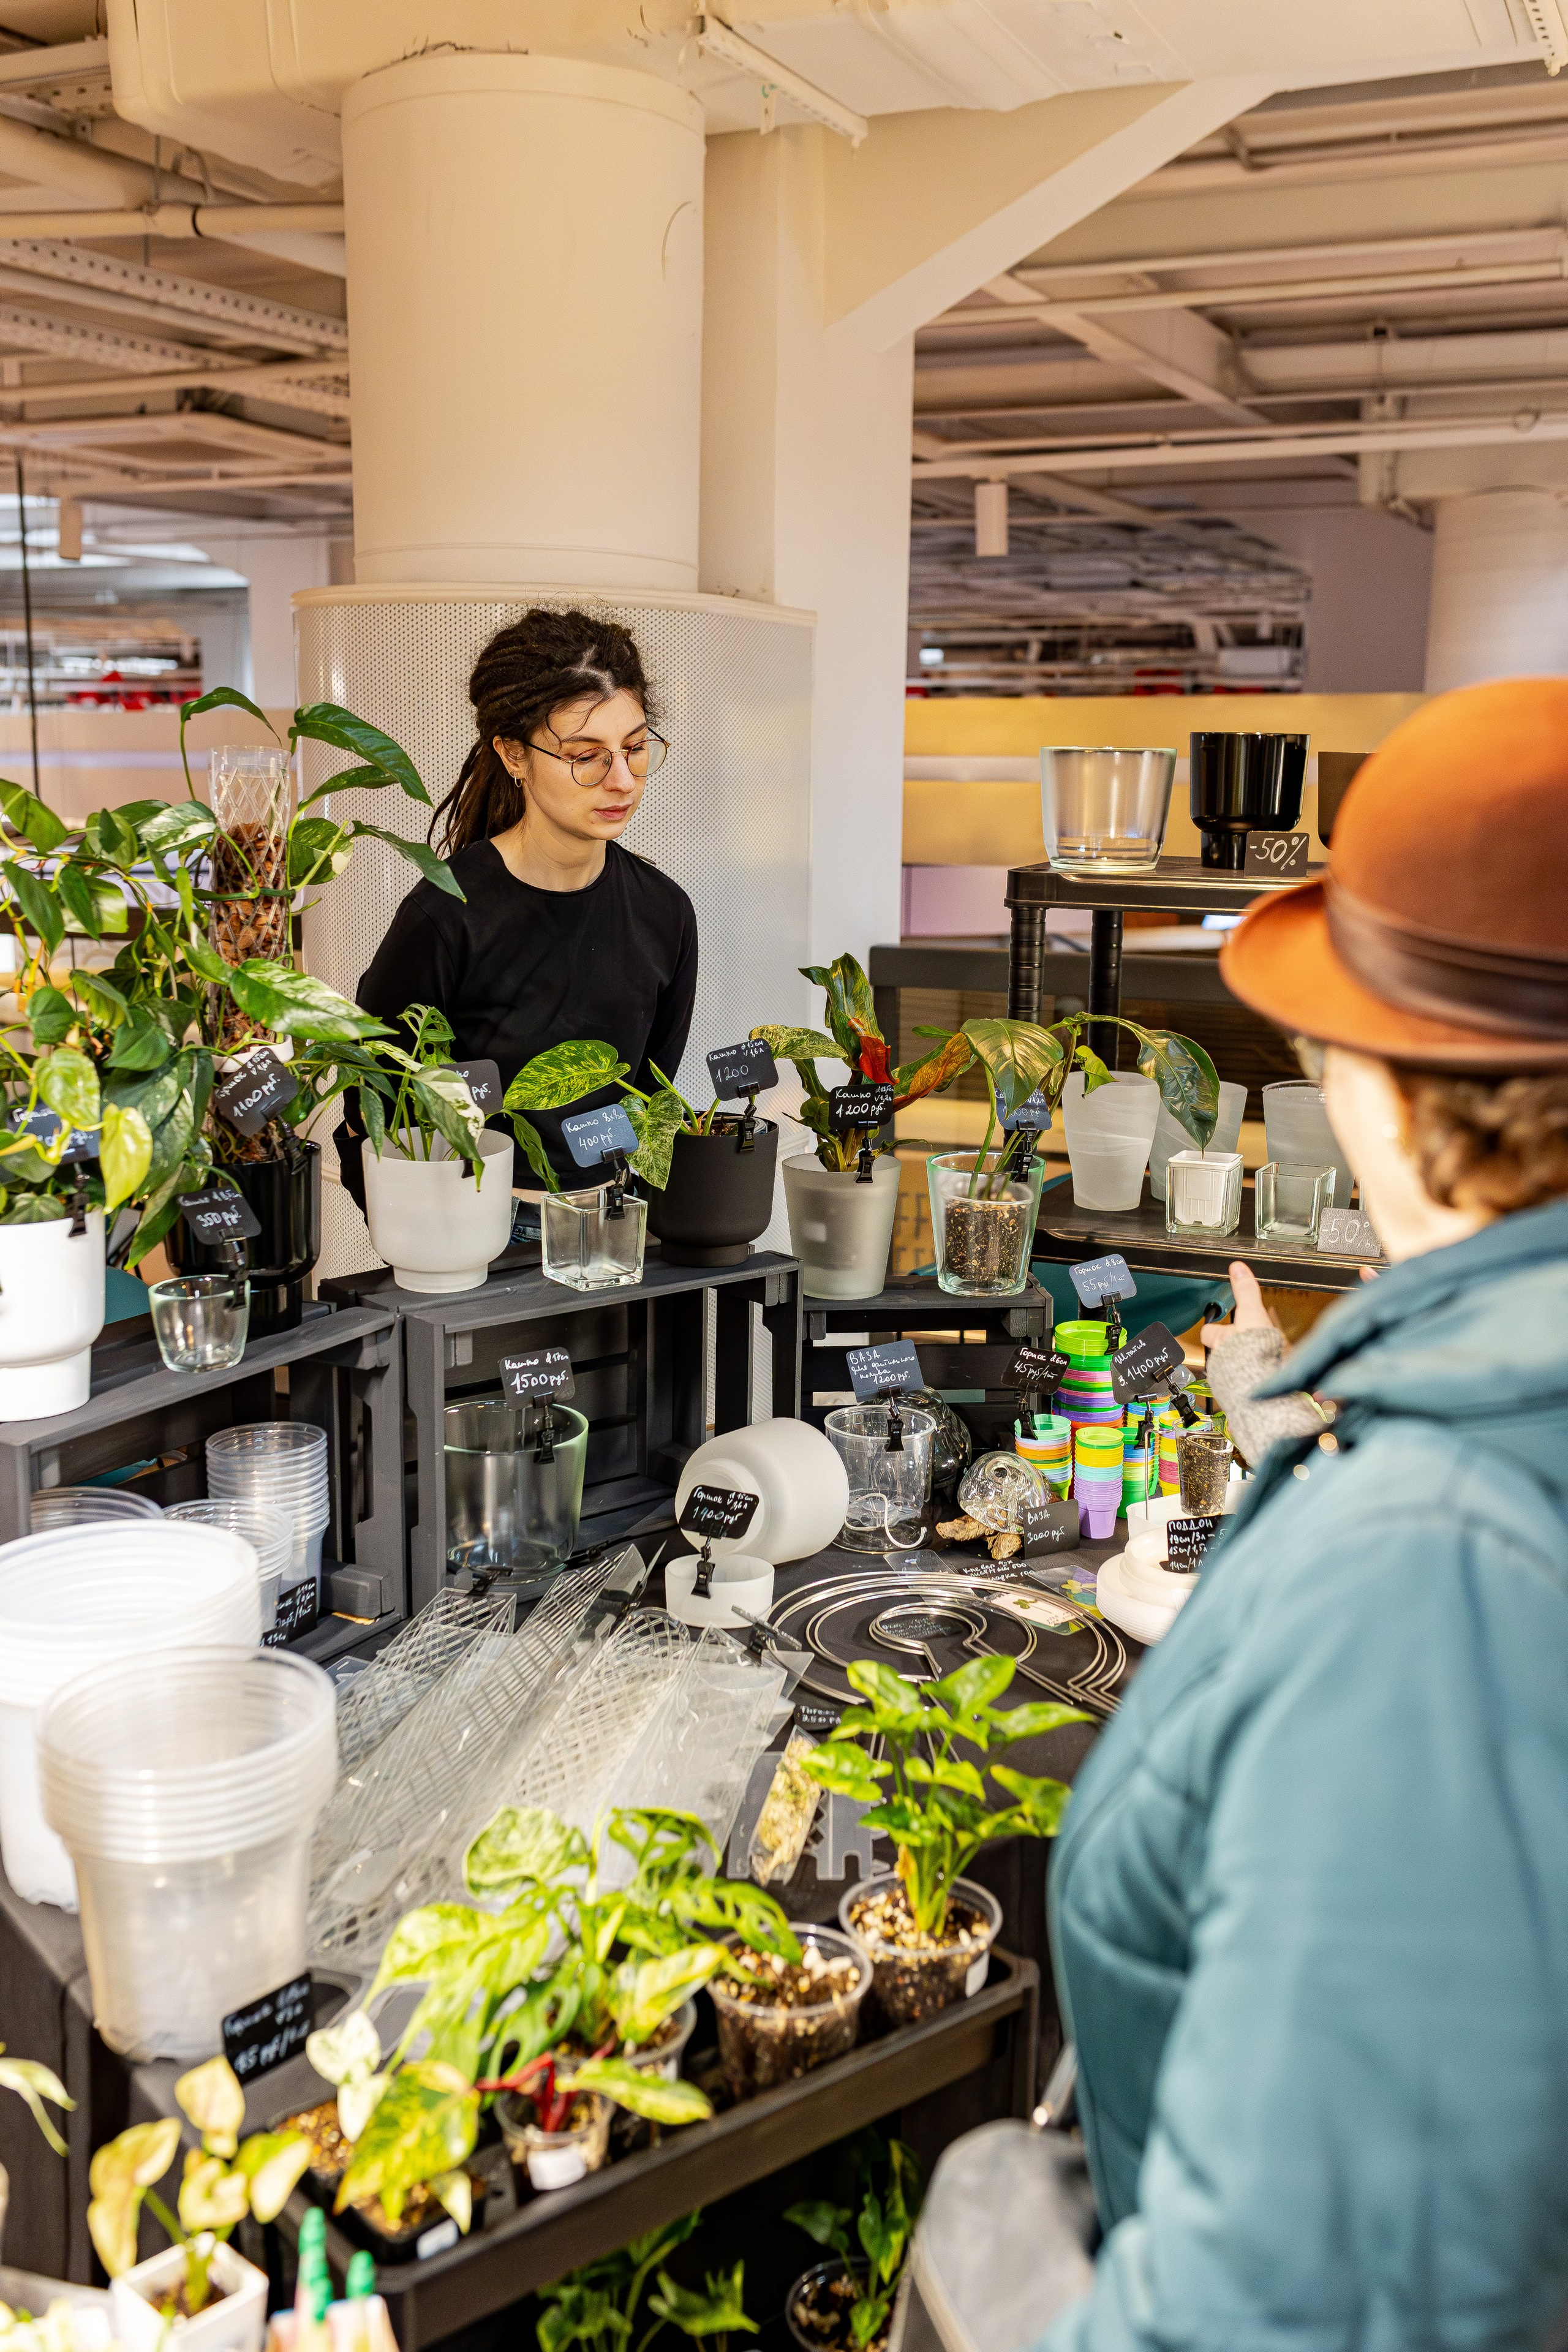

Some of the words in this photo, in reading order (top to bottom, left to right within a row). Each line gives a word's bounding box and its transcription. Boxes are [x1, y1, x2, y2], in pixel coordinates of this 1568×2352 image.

[1250, 836, 1307, 870] -50%
[715, 1065, 748, 1083] 1200
[850, 1349, 881, 1365] ВАЗА
[1020, 1348, 1046, 1361] Горшок
[1027, 1509, 1050, 1525] ВАЗА
[1168, 1518, 1213, 1532] ПОДДОН
